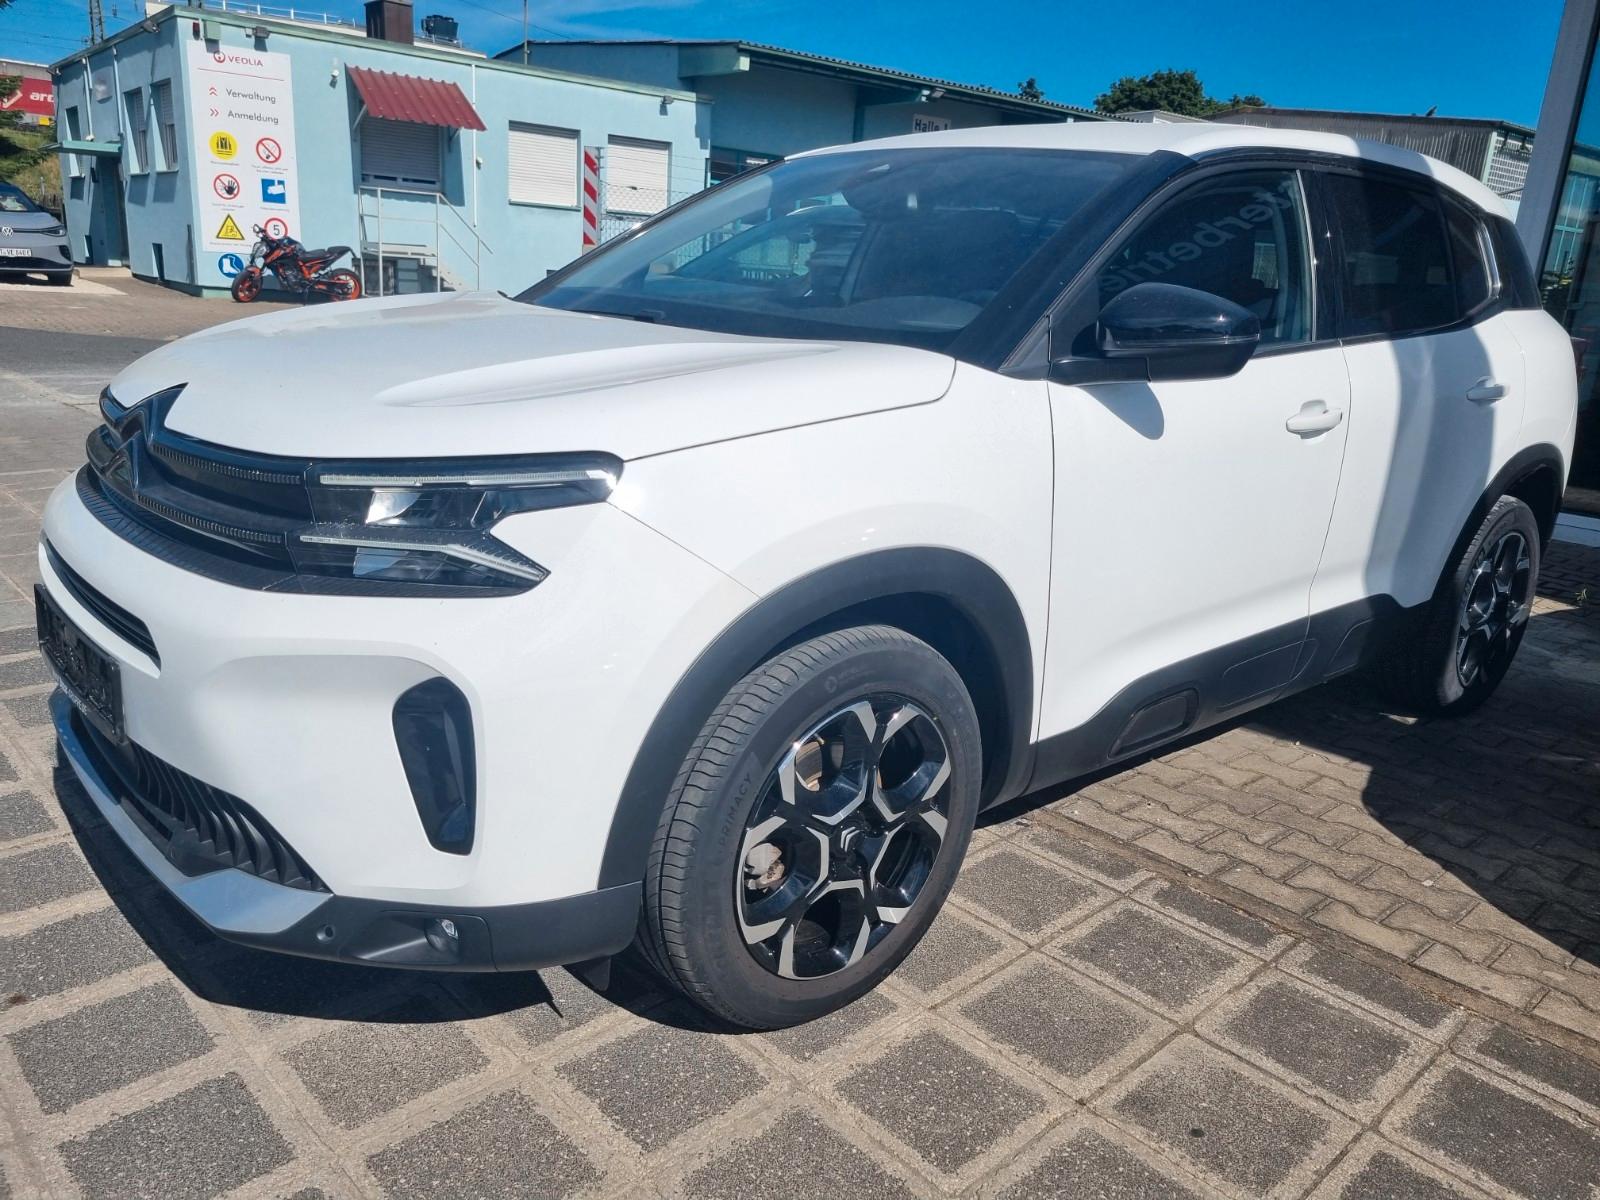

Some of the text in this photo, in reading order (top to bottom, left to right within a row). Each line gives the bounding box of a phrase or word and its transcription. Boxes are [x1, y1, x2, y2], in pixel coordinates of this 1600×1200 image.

[227, 55, 264, 67] VEOLIA
[226, 88, 276, 104] Verwaltung
[228, 110, 279, 125] Anmeldung
[914, 118, 940, 132] Halle
[273, 224, 281, 236] 5
[719, 772, 752, 847] PRIMACY
